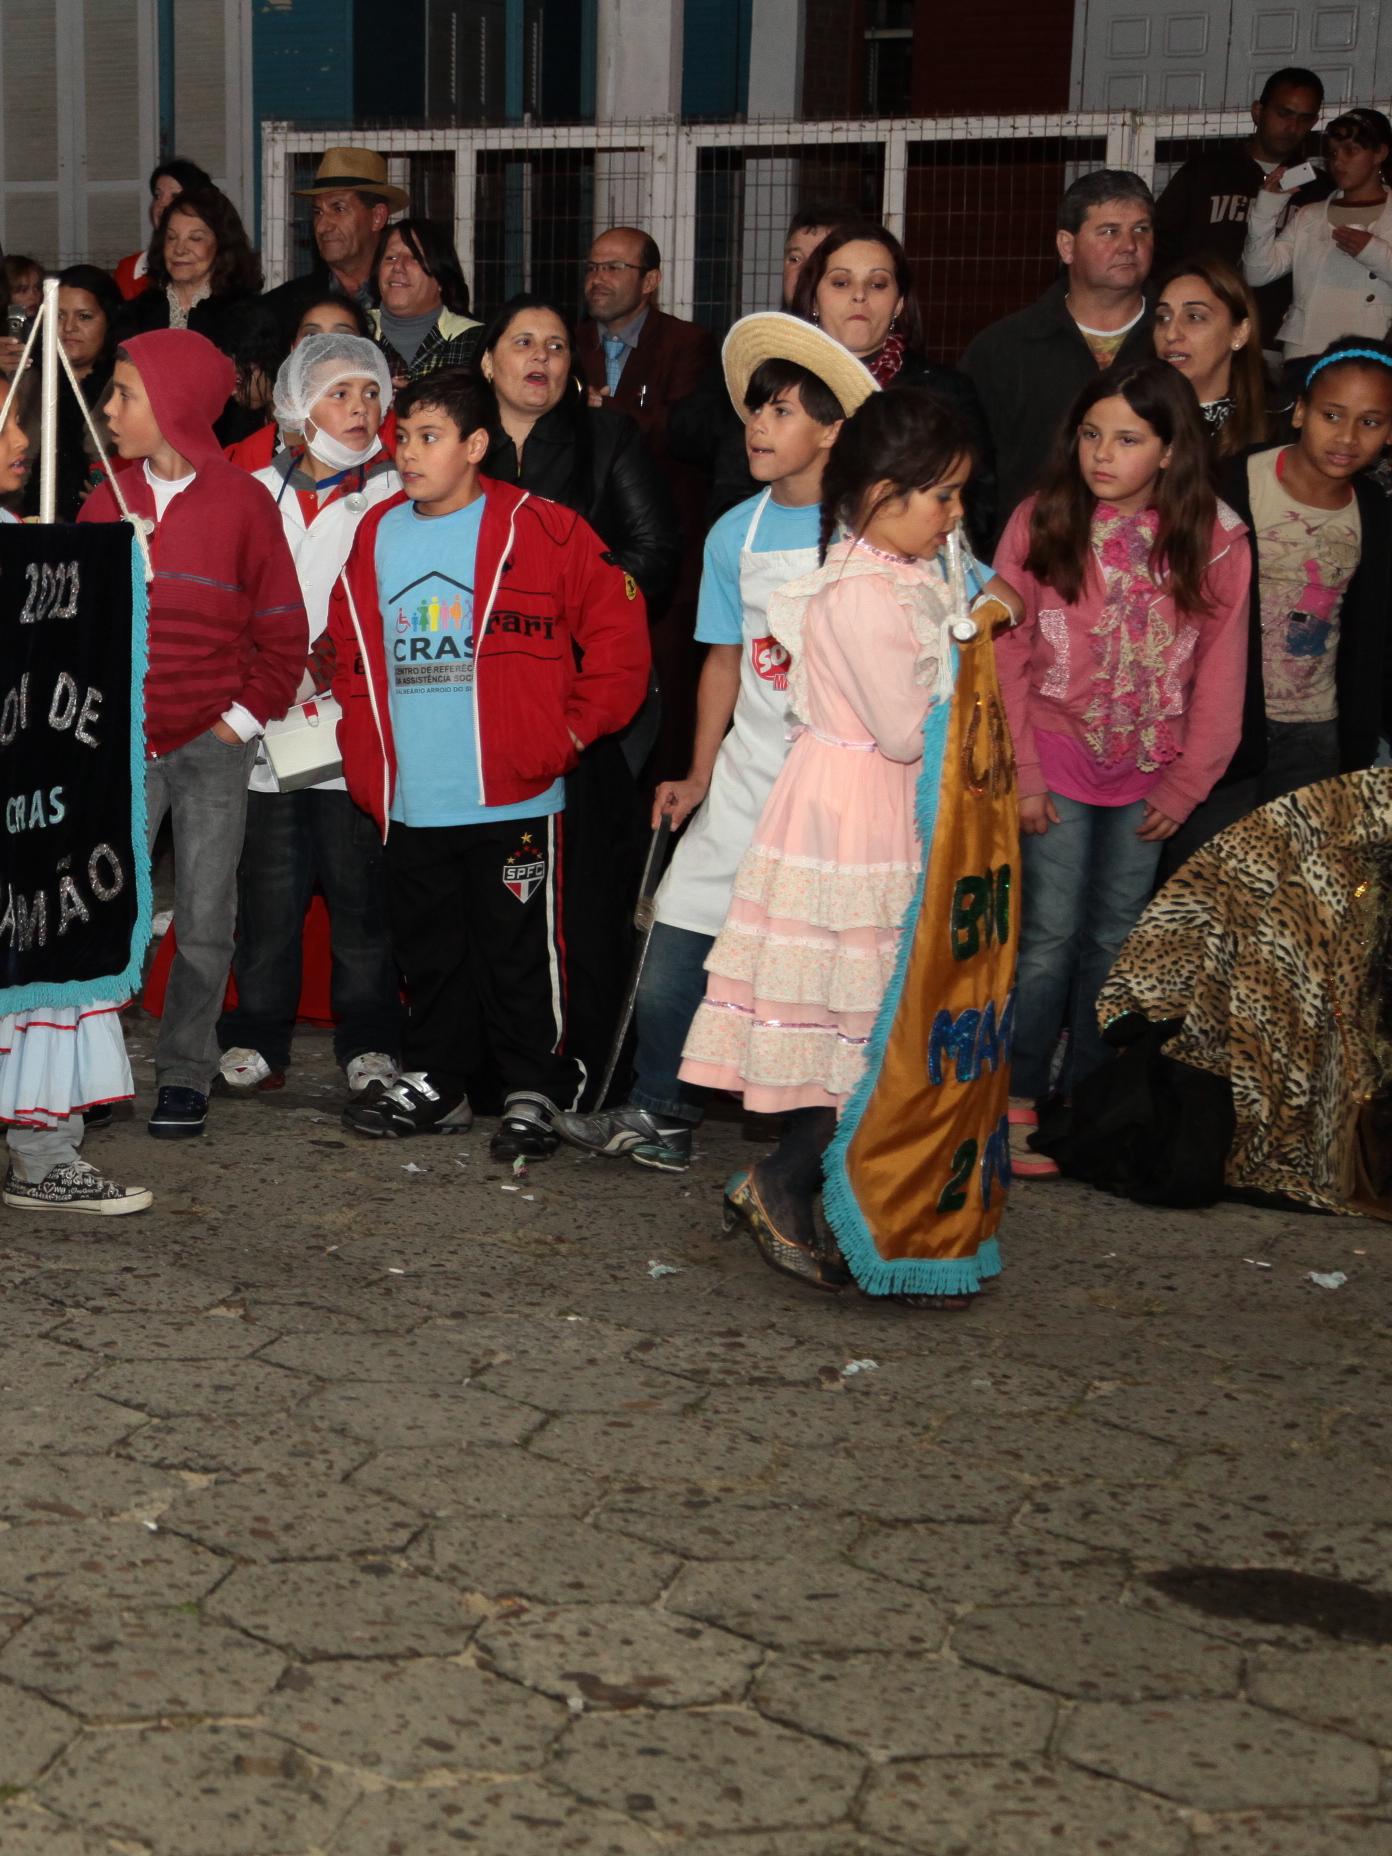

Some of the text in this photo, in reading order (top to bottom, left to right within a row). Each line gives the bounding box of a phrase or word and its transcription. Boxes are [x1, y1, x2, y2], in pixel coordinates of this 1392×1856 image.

[421, 666, 432, 674] DE
[402, 674, 451, 685] ASSISTÊNCIA
[48, 671, 103, 749] DE
[6, 785, 66, 834] CRAS
[506, 865, 543, 880] SPFC
